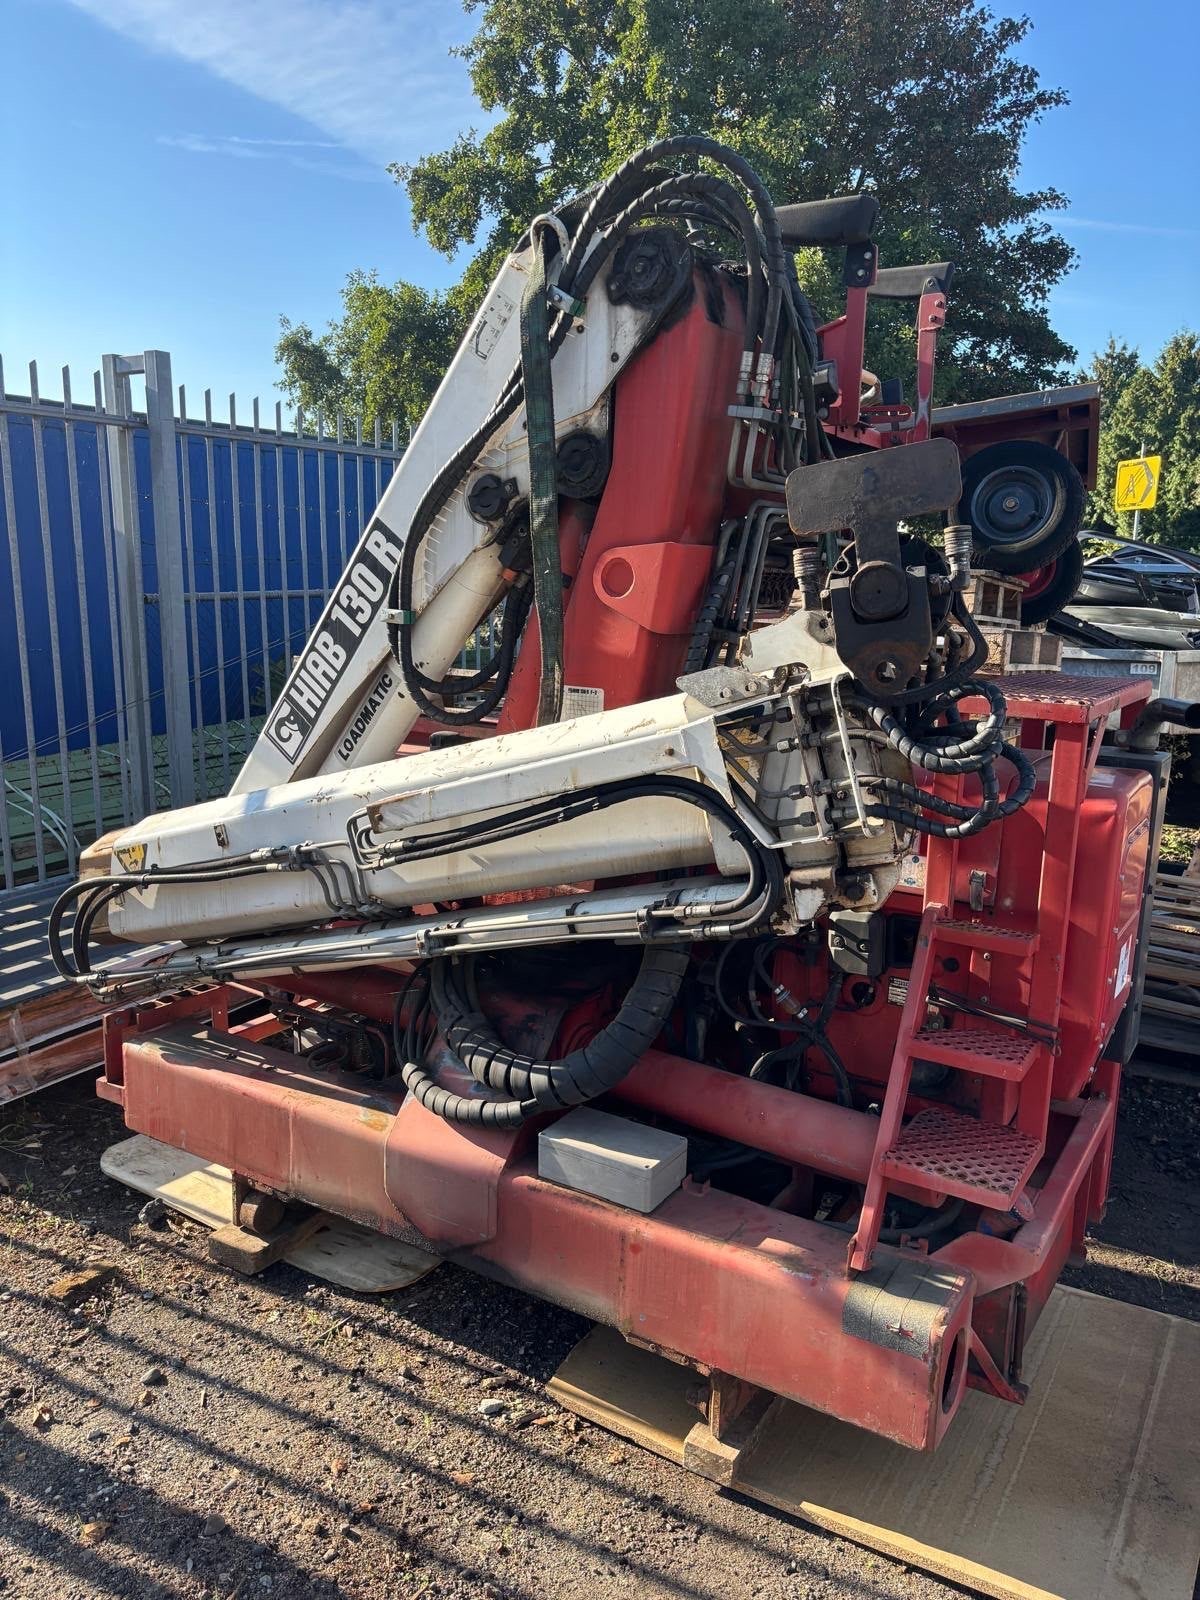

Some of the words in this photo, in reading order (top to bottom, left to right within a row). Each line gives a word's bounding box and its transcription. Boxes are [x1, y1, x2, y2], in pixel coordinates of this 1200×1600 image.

[288, 630, 347, 719] HIAB
[331, 562, 384, 637] 130
[364, 530, 401, 575] R
[1132, 664, 1156, 673] 109
[337, 673, 393, 762] LOADMATIC
